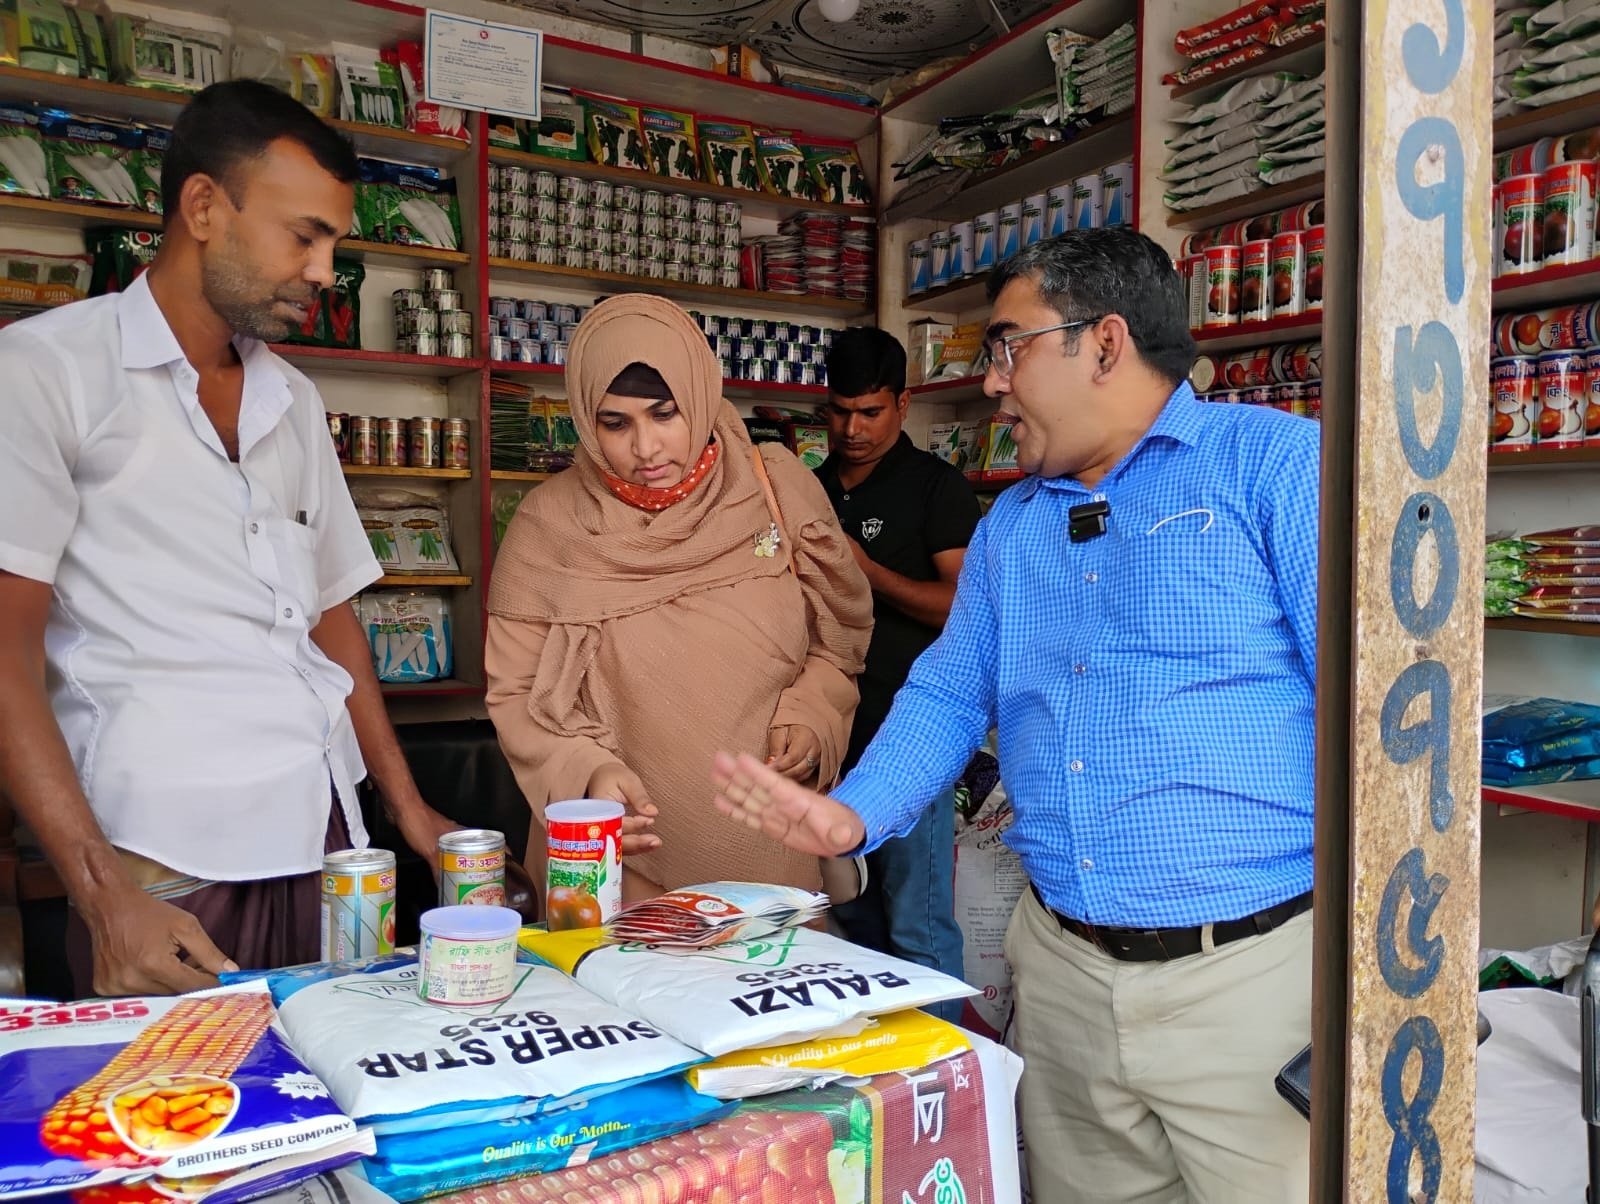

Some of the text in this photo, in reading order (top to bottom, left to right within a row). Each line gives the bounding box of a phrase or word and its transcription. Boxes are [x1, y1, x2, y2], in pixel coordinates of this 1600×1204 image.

[0, 1000, 150, 1032] 3355
[730, 971, 912, 1017] BALAZI
[356, 1019, 663, 1078] SUPER STAR
[176, 1120, 352, 1169] BROTHERS SEED COMPANY
[482, 1141, 533, 1163] Quality
[535, 1136, 547, 1151] is
[549, 1131, 577, 1148] Our
